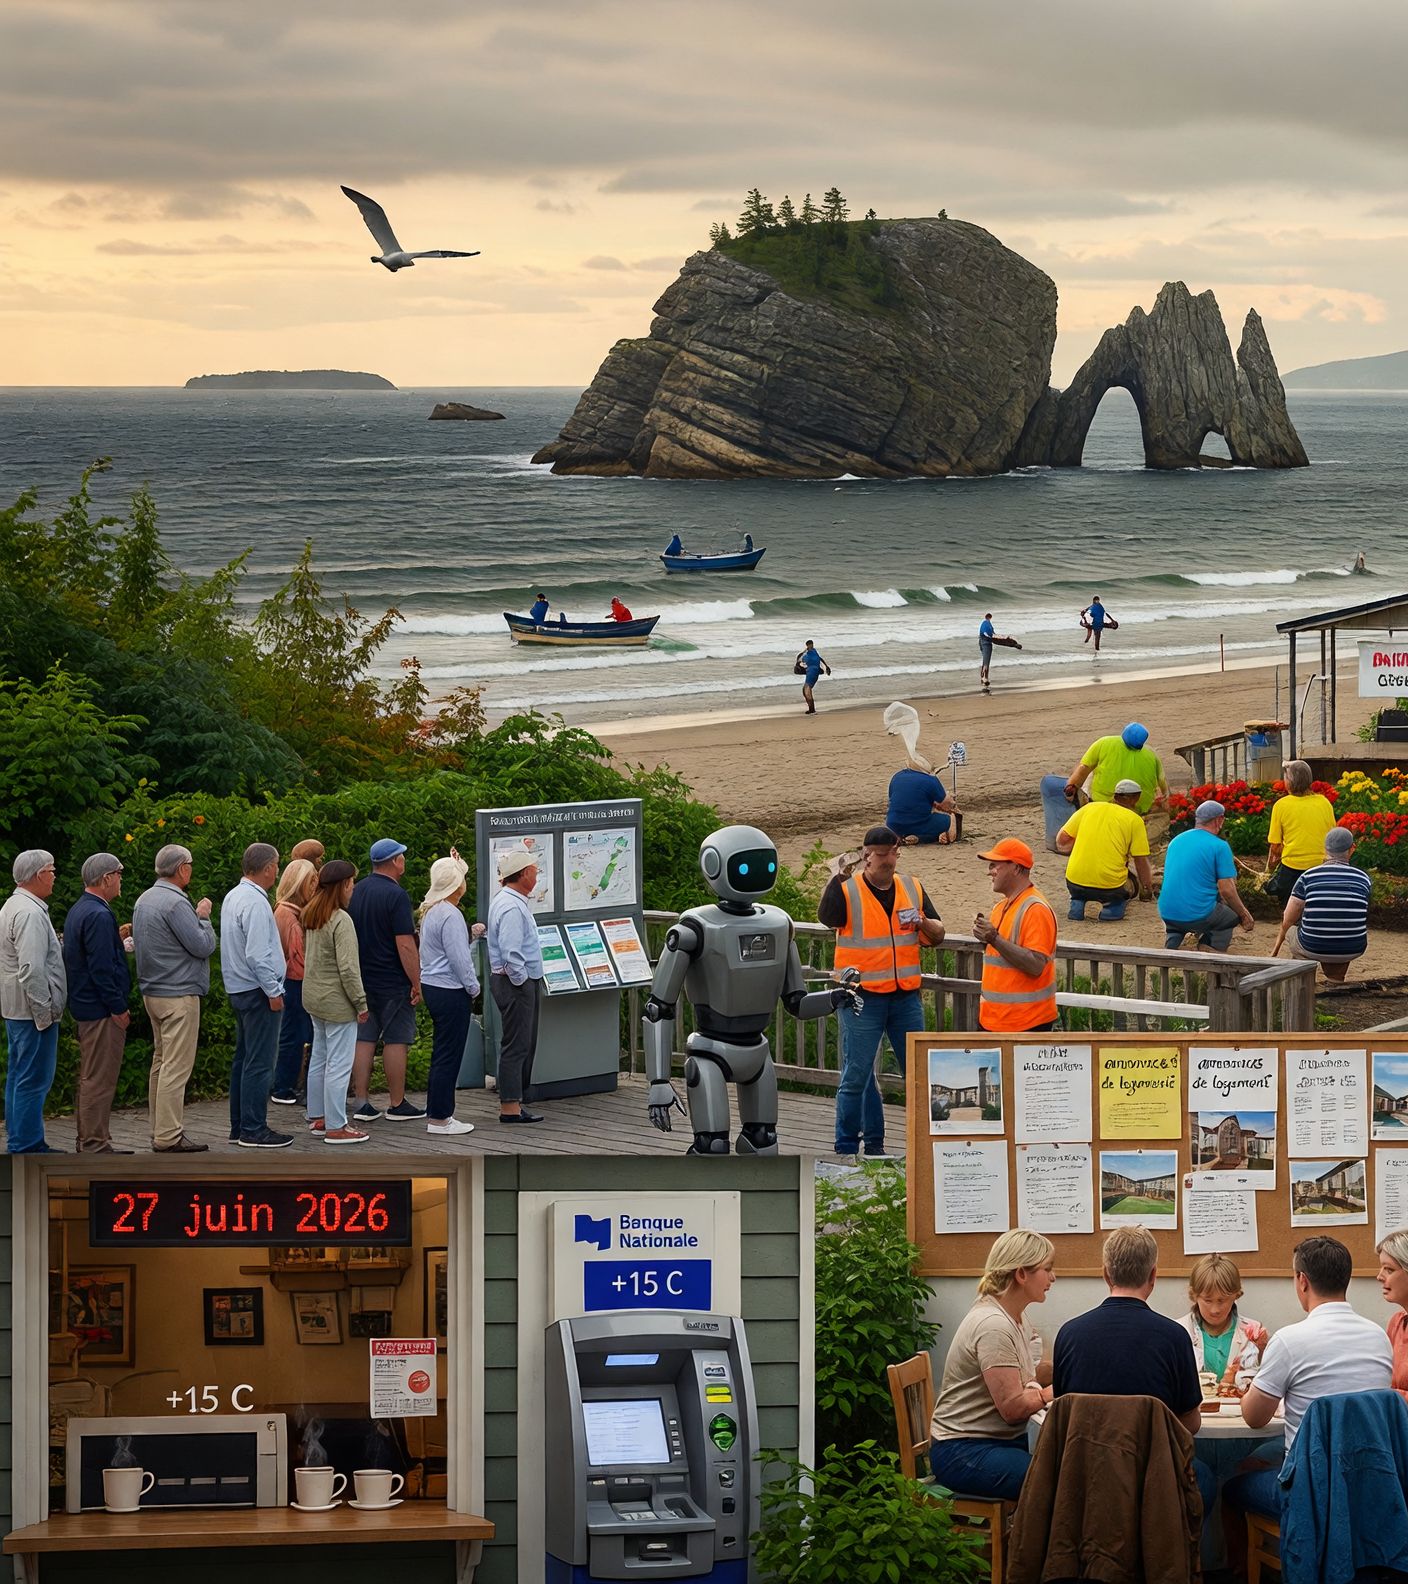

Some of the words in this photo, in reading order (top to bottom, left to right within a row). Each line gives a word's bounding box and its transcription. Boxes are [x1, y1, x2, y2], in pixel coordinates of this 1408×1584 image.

[1101, 1075, 1115, 1089] de
[1192, 1076, 1208, 1089] de
[112, 1192, 159, 1233] 27
[184, 1193, 273, 1238] juin
[296, 1192, 389, 1233] 2026
[620, 1214, 684, 1232] Banque
[619, 1233, 698, 1249] Nationale
[612, 1271, 658, 1296] +15
[666, 1270, 683, 1295] C
[166, 1385, 219, 1413] +15
[231, 1384, 254, 1412] C
